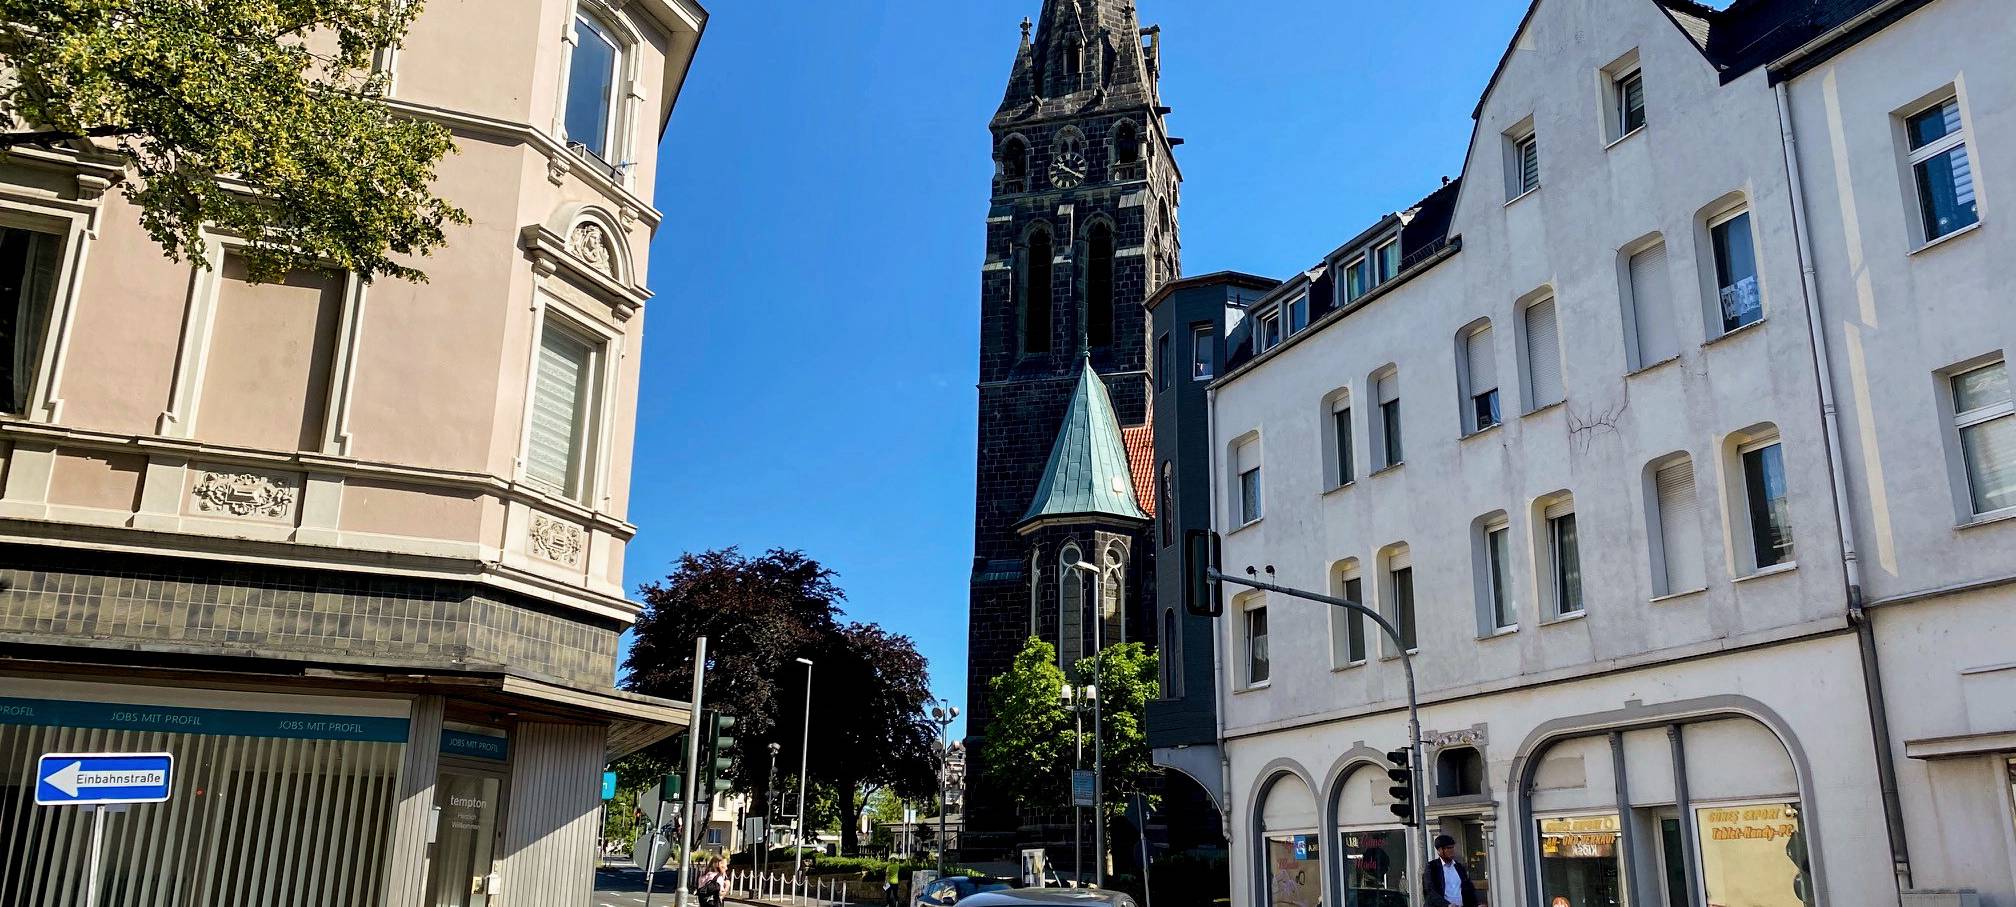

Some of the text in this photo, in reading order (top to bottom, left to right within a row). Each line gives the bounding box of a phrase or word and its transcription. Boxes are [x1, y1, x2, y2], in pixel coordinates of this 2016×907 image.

[111, 711, 202, 726] JOBS MIT PROFIL
[279, 720, 364, 733] JOBS MIT PROFIL
[448, 738, 499, 753] JOBS MIT PROFIL
[76, 773, 161, 785] Einbahnstraße
[450, 794, 487, 809] tempton
